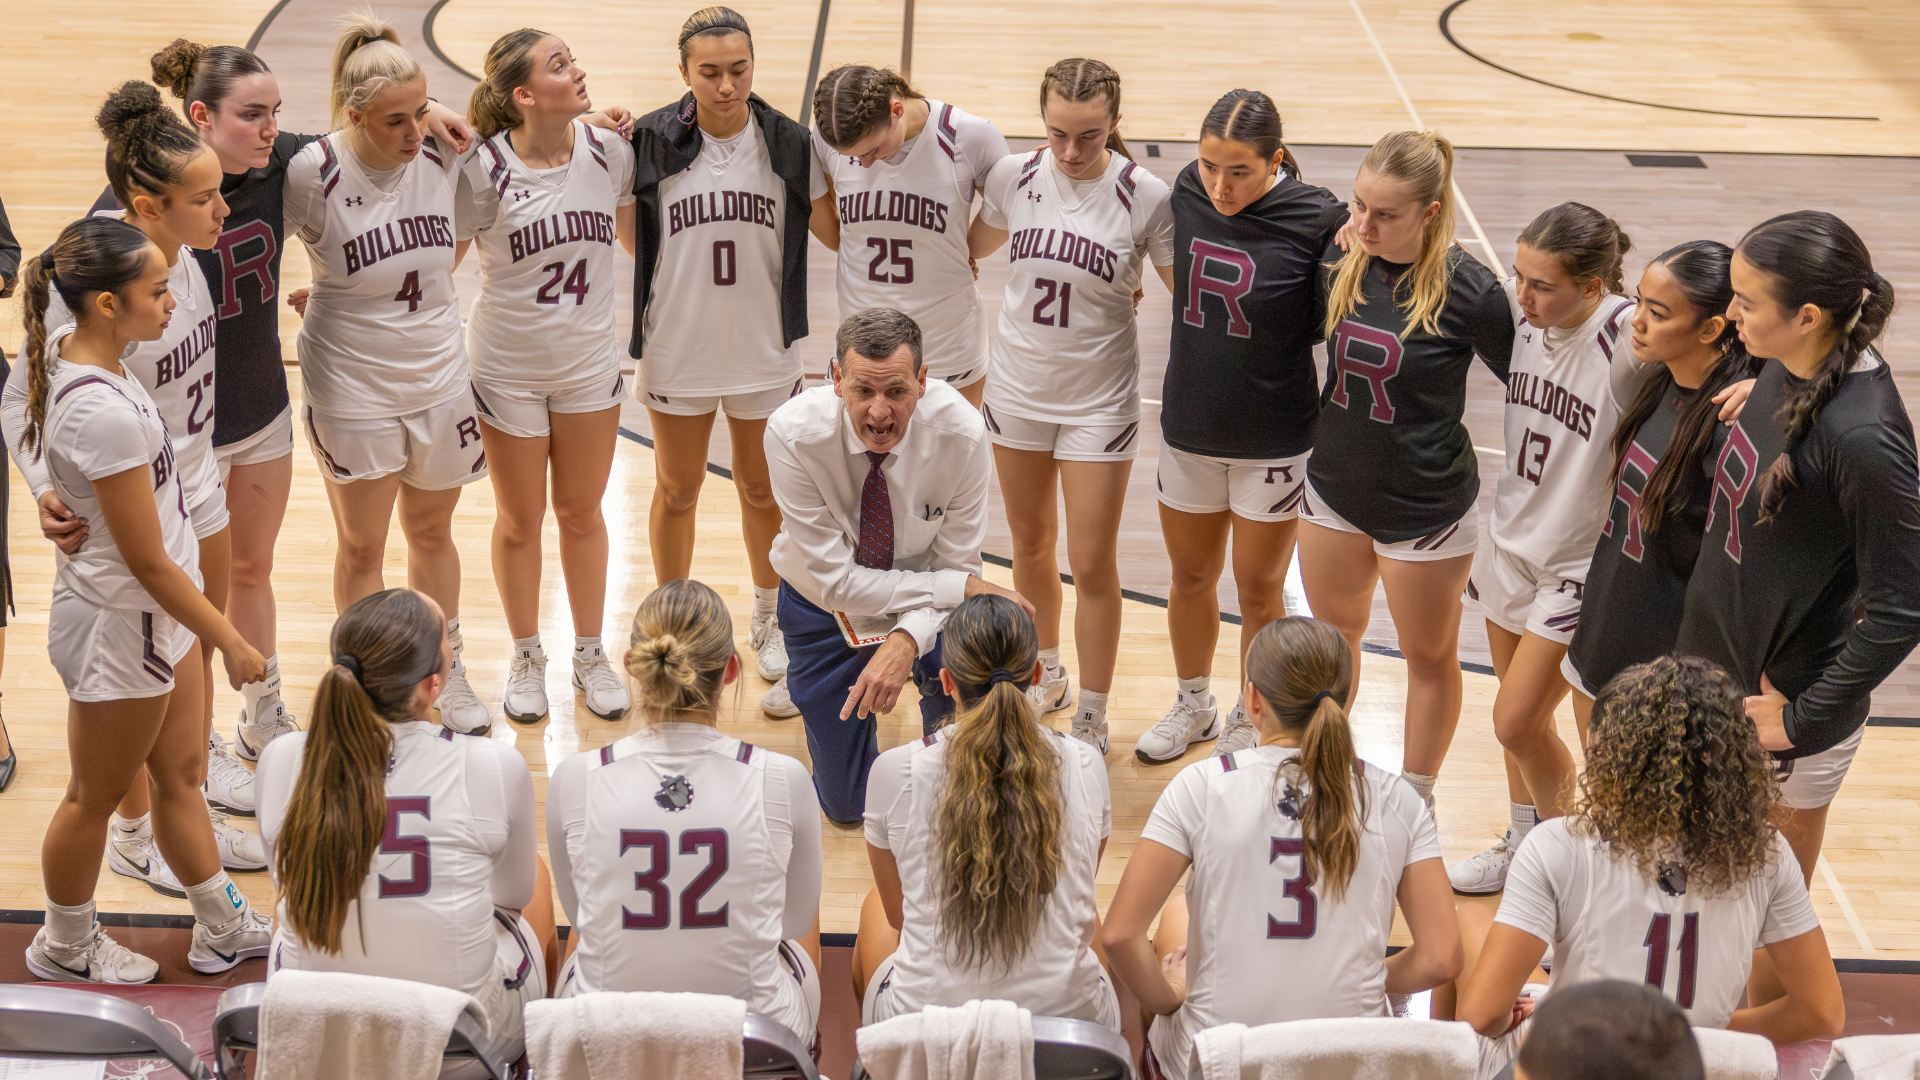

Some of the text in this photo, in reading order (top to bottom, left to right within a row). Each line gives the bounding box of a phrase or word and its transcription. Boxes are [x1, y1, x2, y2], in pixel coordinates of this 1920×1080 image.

[508, 210, 614, 265] BULLDOGS
[668, 190, 776, 238] BULLDOGS
[838, 190, 949, 234] BULLDOGS
[211, 218, 278, 321] R
[342, 214, 454, 277] BULLDOGS
[712, 239, 737, 287] 0
[866, 236, 915, 285] 25
[1009, 227, 1118, 284] BULLDOGS
[393, 269, 423, 313] 4
[535, 257, 591, 306] 24
[1032, 277, 1072, 329] 21
[1182, 236, 1257, 339] R
[154, 312, 216, 390] BULLDO
[1330, 319, 1405, 425] R
[455, 415, 482, 450] R
[1516, 426, 1552, 487] 13
[1602, 439, 1660, 564] R
[1705, 418, 1760, 565] R
[377, 795, 432, 900] 5
[619, 827, 730, 931] 32
[1266, 835, 1319, 940] 3
[1642, 911, 1700, 1010] 11
